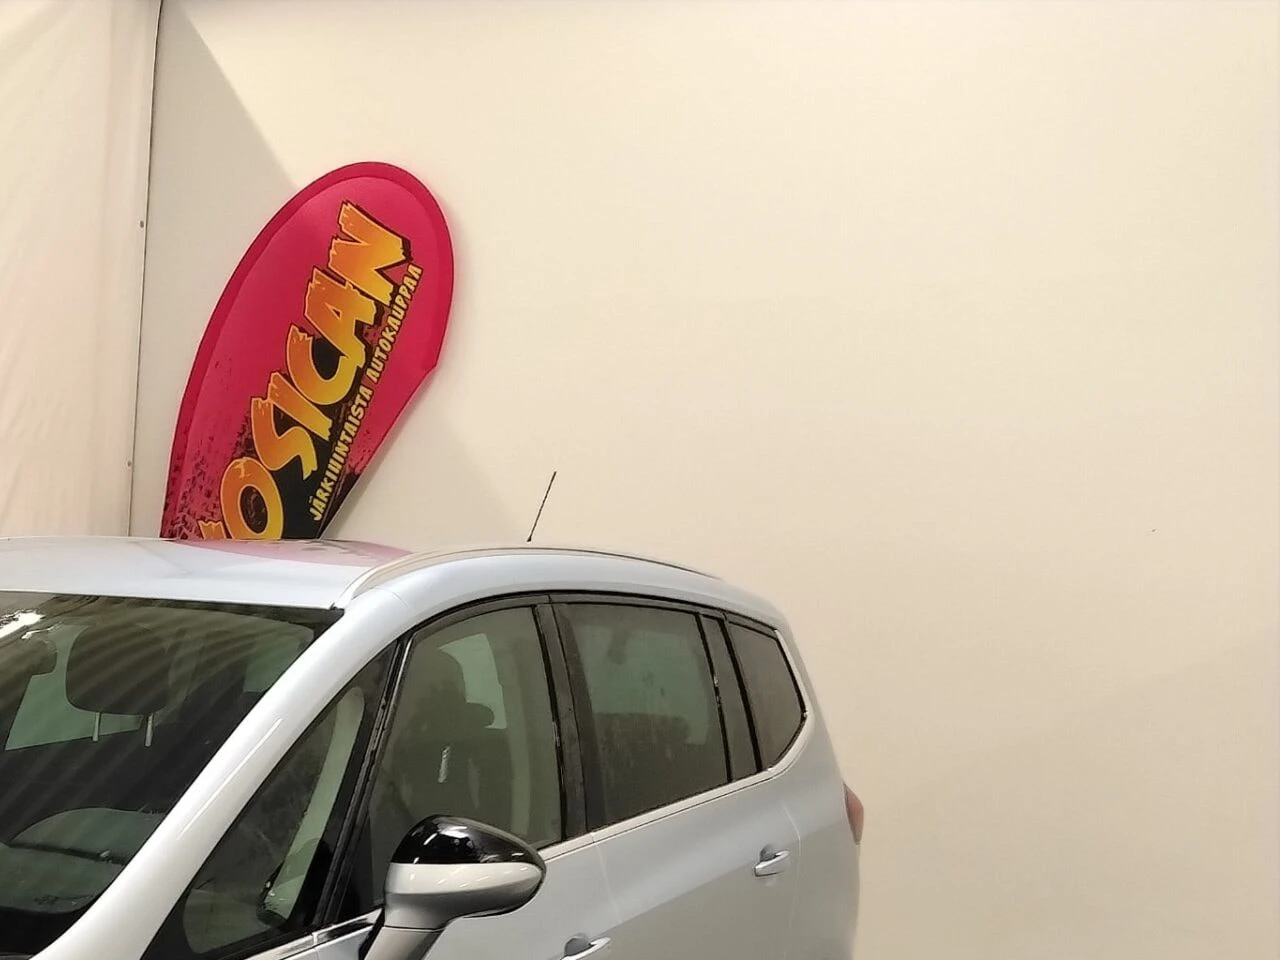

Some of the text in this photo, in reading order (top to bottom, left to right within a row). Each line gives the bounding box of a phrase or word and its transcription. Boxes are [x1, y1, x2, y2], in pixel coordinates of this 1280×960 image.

[198, 201, 407, 540] OSICAN
[309, 263, 423, 521] JÄRKIHINTAISTA AUTOKAUPPAA
